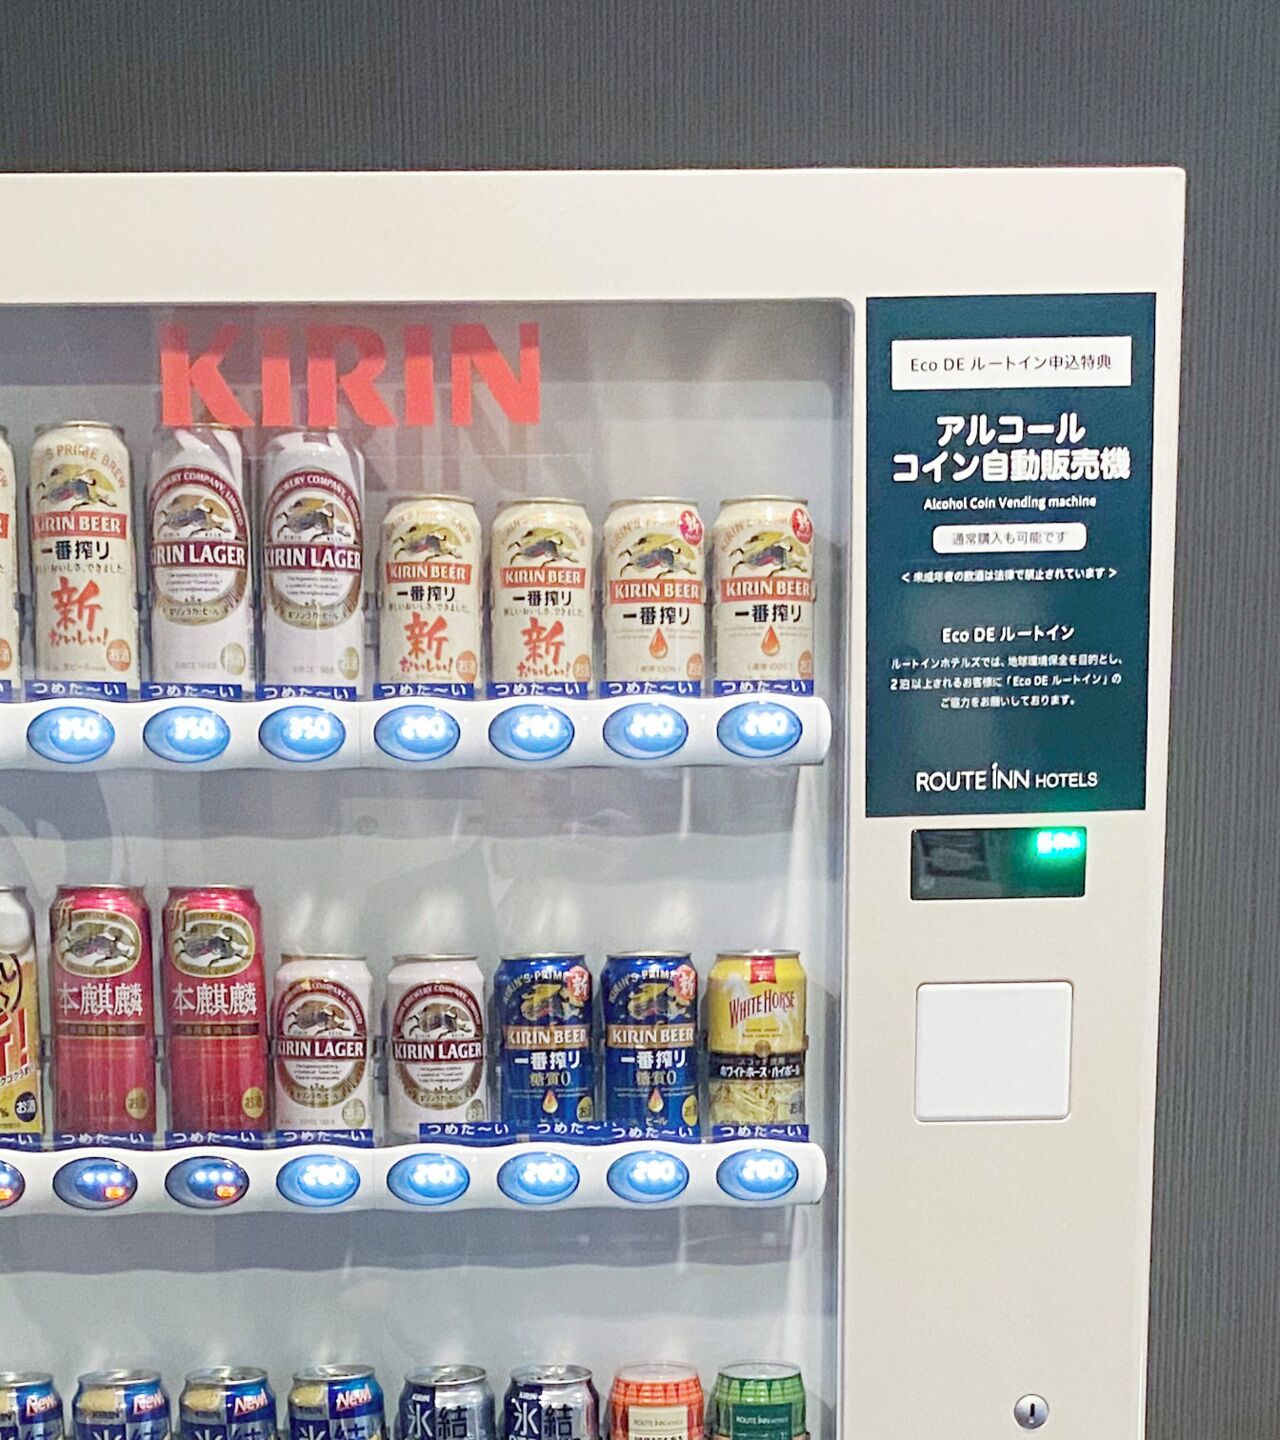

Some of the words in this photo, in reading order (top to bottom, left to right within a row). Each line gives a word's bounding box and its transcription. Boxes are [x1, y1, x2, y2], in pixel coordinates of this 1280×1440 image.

[910, 358, 938, 371] Eco
[944, 357, 965, 371] DE
[971, 354, 1111, 371] ルートイン申込特典
[161, 323, 540, 427] KIRIN
[937, 413, 1086, 446] アルコール
[892, 446, 1131, 482] コイン自動販売機
[924, 497, 967, 510] Alcohol
[970, 497, 996, 509] Coin
[999, 496, 1046, 511] Vending
[1049, 496, 1096, 508] machine
[79, 516, 120, 534] BEER
[952, 532, 1067, 546] 通常購入も可能です
[40, 540, 109, 560] 一番搾り
[189, 546, 245, 565] LAGER
[311, 549, 361, 570] LAGER
[390, 564, 429, 579] KIRIN
[431, 565, 466, 580] BEER
[505, 570, 545, 584] KIRIN
[548, 571, 580, 585] BEER
[396, 586, 455, 602] 一番搾り
[512, 590, 571, 606] 一番搾り
[615, 584, 660, 599] KIRIN
[664, 583, 699, 598] BEER
[726, 582, 772, 596] KIRIN
[776, 581, 810, 596] BEER
[51, 575, 103, 632] 新
[734, 604, 802, 622] 一番搾り
[623, 606, 690, 625] 一番搾り
[404, 612, 448, 660] 新
[521, 616, 565, 665] 新
[942, 628, 969, 643] Eco
[974, 627, 995, 642] DE
[1000, 625, 1074, 641] ルートイン
[1034, 675, 1048, 687] DE
[58, 717, 100, 740] 350
[174, 717, 216, 739] 350
[289, 716, 331, 739] 350
[915, 770, 987, 792] ROUTE
[1035, 772, 1098, 788] HOTELS
[571, 974, 589, 997] 新
[680, 974, 695, 997] 新
[57, 982, 143, 1016] 本麒麟
[171, 982, 257, 1016] 本麒麟
[729, 997, 762, 1029] WHITE
[763, 989, 795, 1012] HORSE
[508, 1030, 551, 1044] KIRIN
[555, 1029, 587, 1044] BEER
[613, 1029, 656, 1044] KIRIN
[661, 1027, 693, 1042] BEER
[315, 1041, 364, 1057] LAGER
[394, 1044, 435, 1059] KIRIN
[438, 1042, 482, 1059] LAGER
[515, 1052, 580, 1070] 一番搾り
[621, 1050, 687, 1070] 一番搾り
[16, 1099, 36, 1113] お酒
[26, 1394, 56, 1416] New!
[134, 1392, 165, 1415] New!
[234, 1389, 268, 1416] New!
[336, 1386, 371, 1411] New!
[408, 1402, 468, 1438] 氷結
[514, 1402, 573, 1437] 氷結
